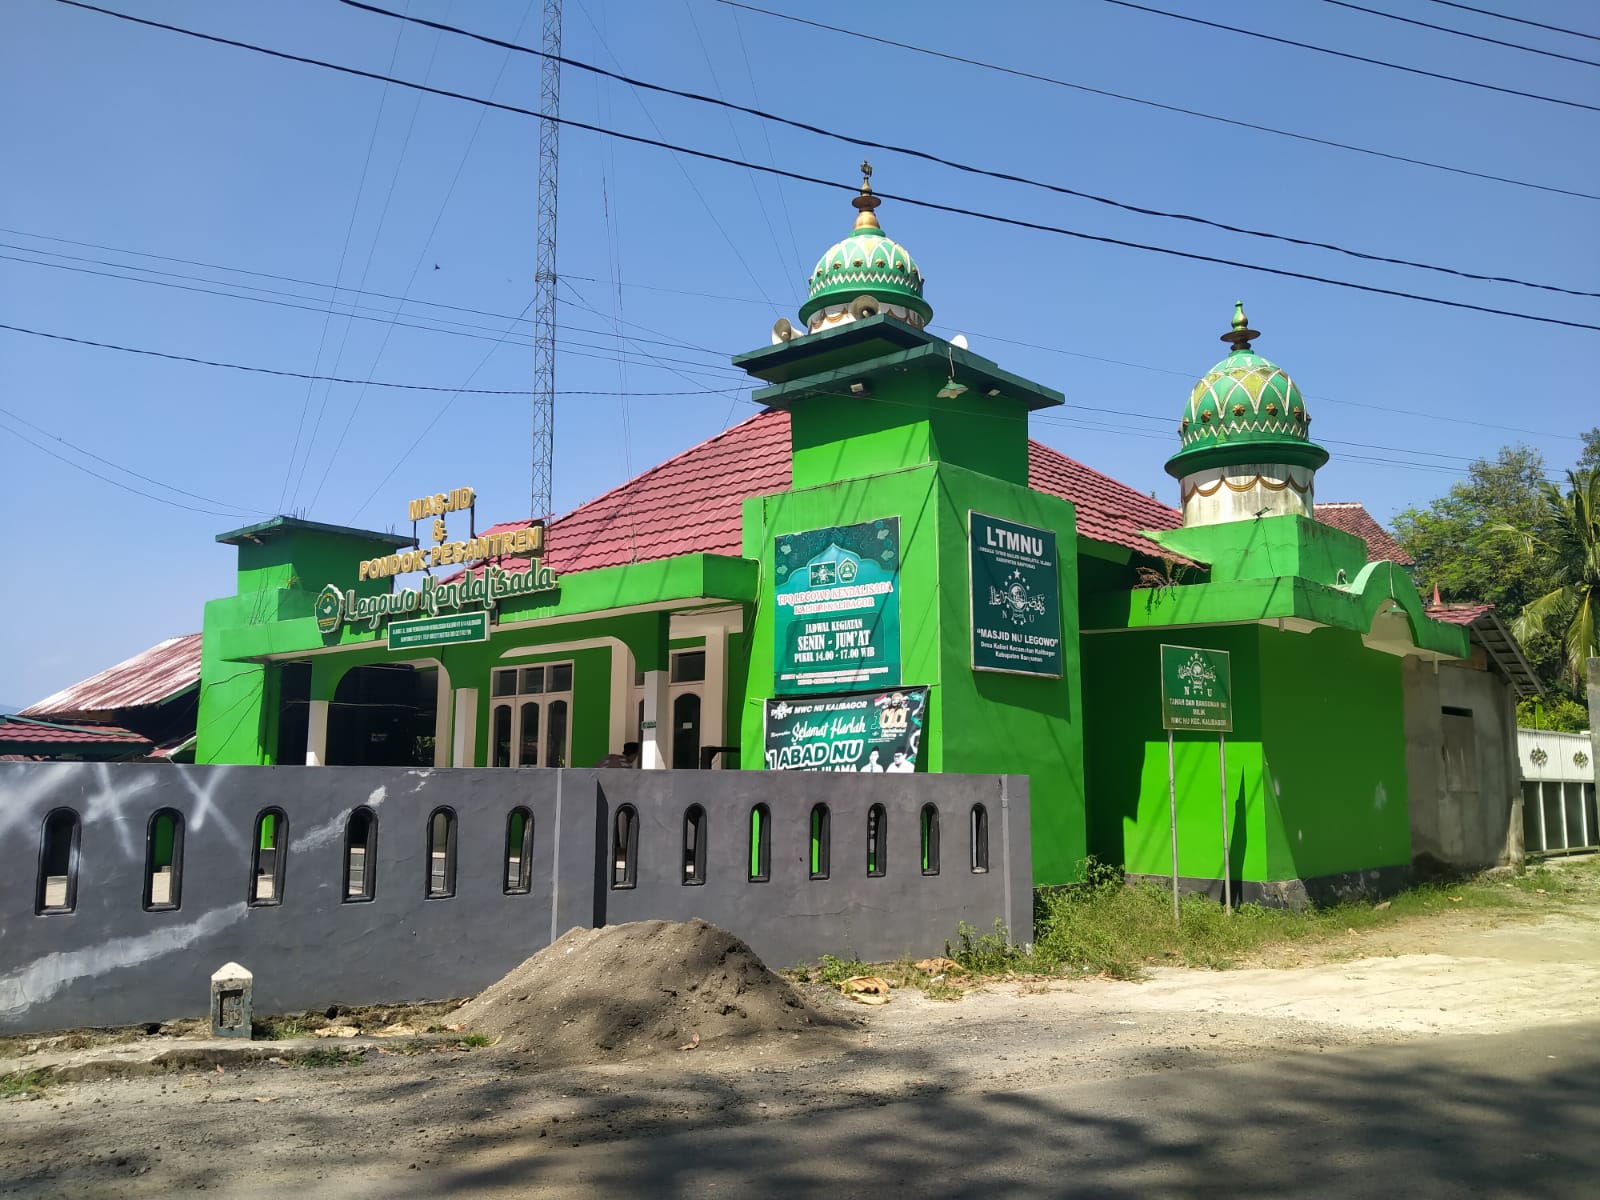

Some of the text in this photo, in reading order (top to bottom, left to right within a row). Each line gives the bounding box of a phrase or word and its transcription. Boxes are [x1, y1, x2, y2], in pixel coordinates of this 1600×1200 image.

[408, 486, 475, 521] MASJID
[432, 519, 448, 542] &
[986, 526, 1043, 557] LTMNU
[359, 526, 544, 581] PONDOK PESANTREN
[344, 557, 559, 629] Legowo Kendalisada
[777, 580, 894, 607] TPQ LEGOWO KENDALISADA
[827, 597, 875, 611] KALIBAGOR
[805, 618, 863, 635] JADWAL KEGIATAN
[1002, 609, 1035, 623] N U
[797, 634, 825, 651] SENIN
[835, 629, 871, 650] JUM'AT
[1011, 632, 1023, 643] NU
[815, 650, 834, 662] 14.00
[840, 648, 859, 660] 17.00
[861, 646, 875, 657] WIB
[1183, 686, 1213, 697] N U
[793, 700, 868, 715] MWC NU KALIBAGOR
[790, 719, 829, 743] Selamat
[830, 715, 867, 739] Harlah
[767, 739, 864, 770] 1 ABAD NU
